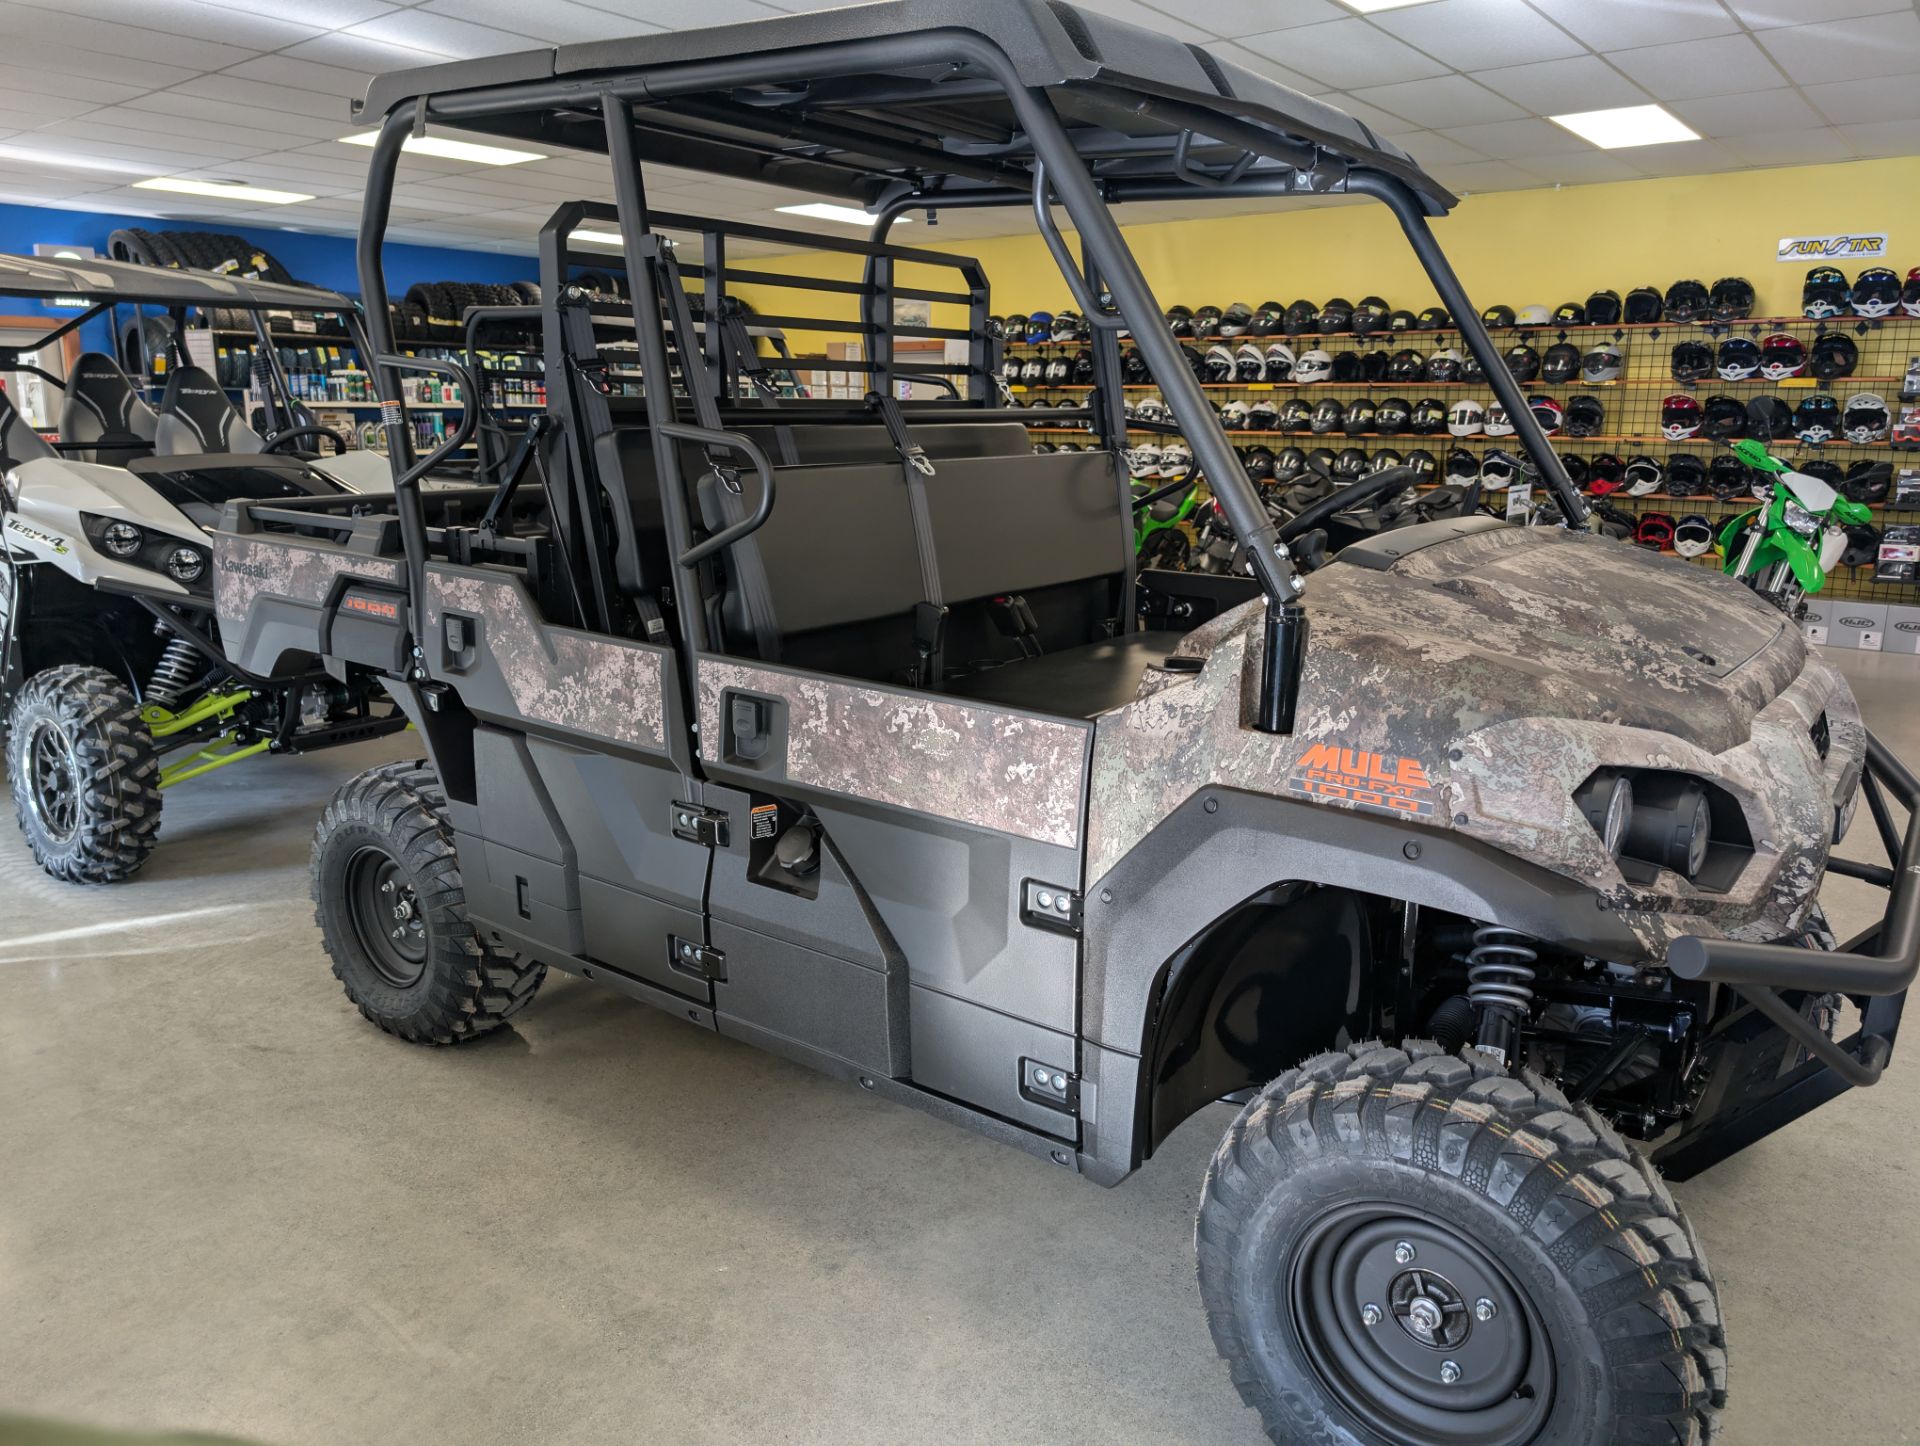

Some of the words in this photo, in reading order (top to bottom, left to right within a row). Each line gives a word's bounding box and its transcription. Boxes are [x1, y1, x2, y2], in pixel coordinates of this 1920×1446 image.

[221, 555, 268, 579] Kawasaki
[1296, 743, 1432, 788] MULE
[1302, 781, 1419, 812] 1000
[1307, 769, 1414, 797] PRO-FXT
